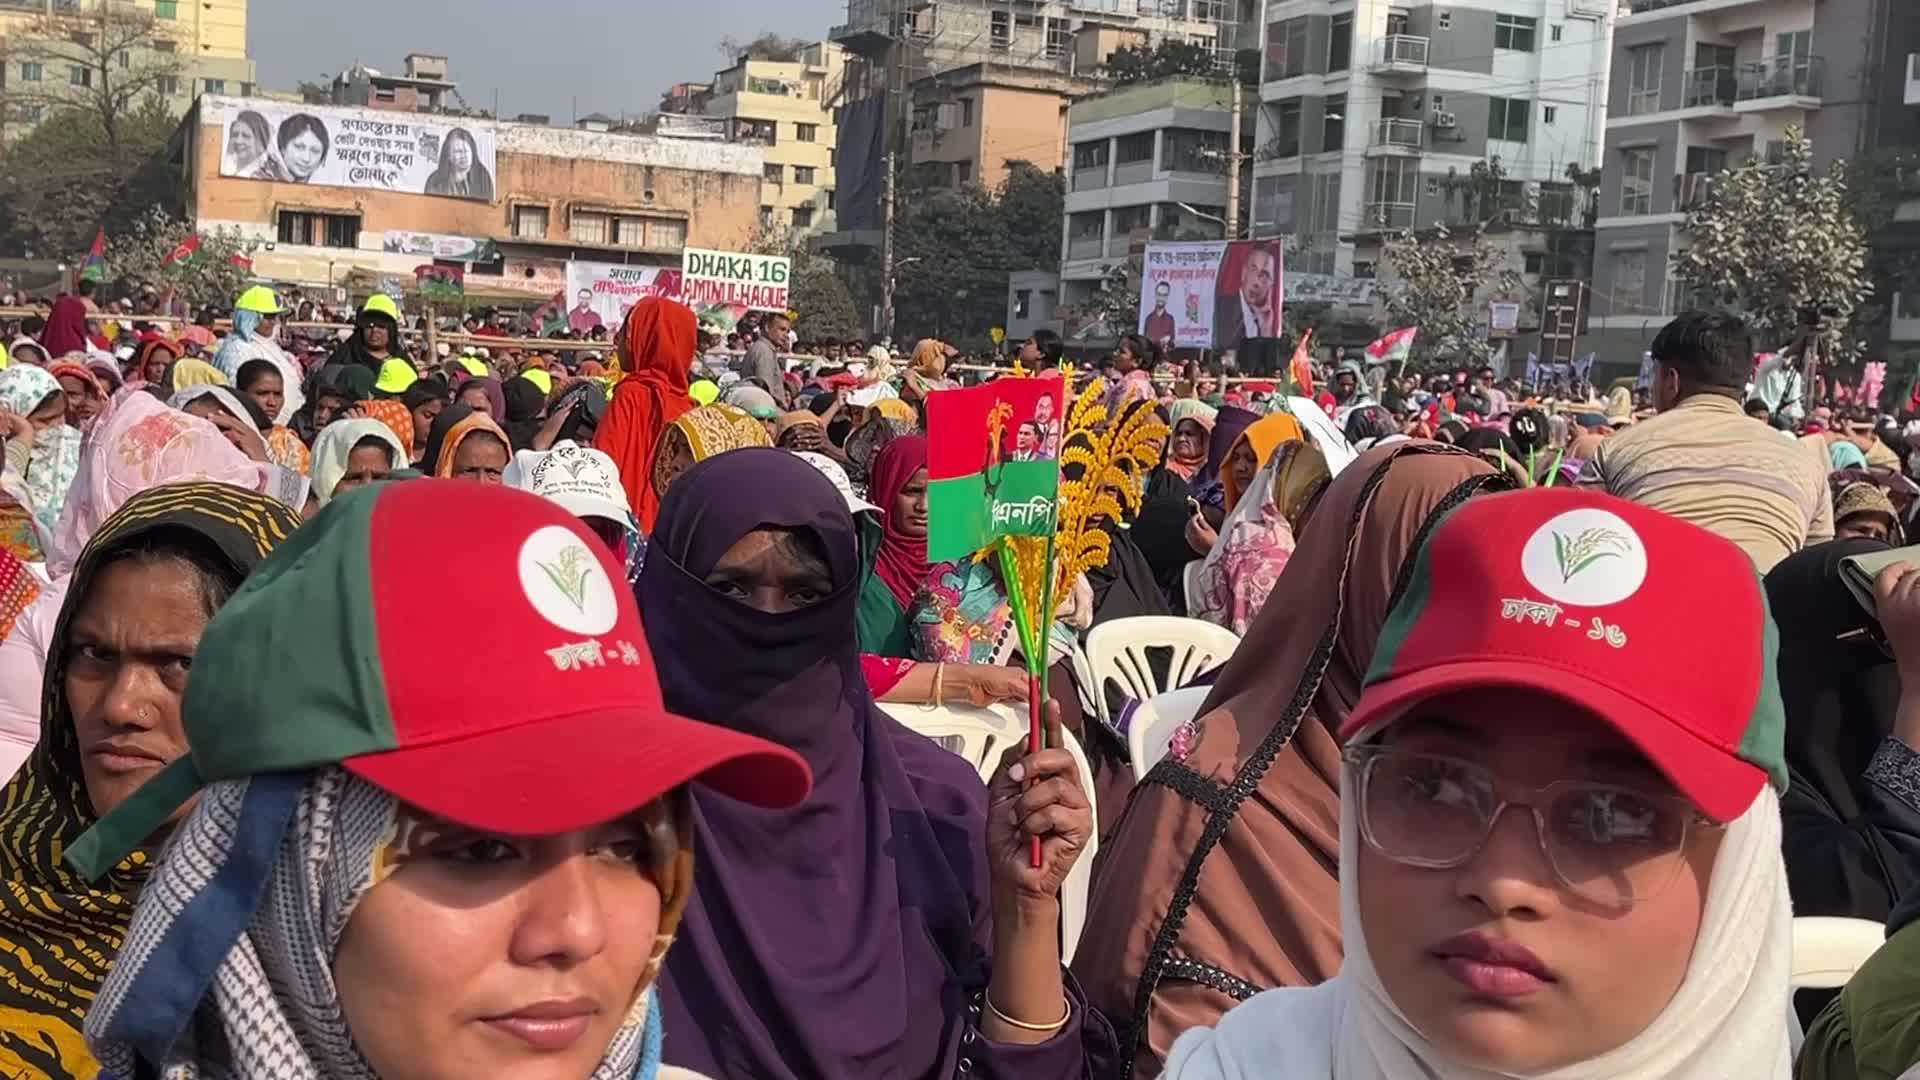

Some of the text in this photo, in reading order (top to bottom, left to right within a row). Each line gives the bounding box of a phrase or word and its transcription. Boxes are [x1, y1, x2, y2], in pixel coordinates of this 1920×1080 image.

[1500, 597, 1564, 628] ঢাকা
[1587, 616, 1627, 648] ১৬
[544, 638, 606, 671] ঢাকা
